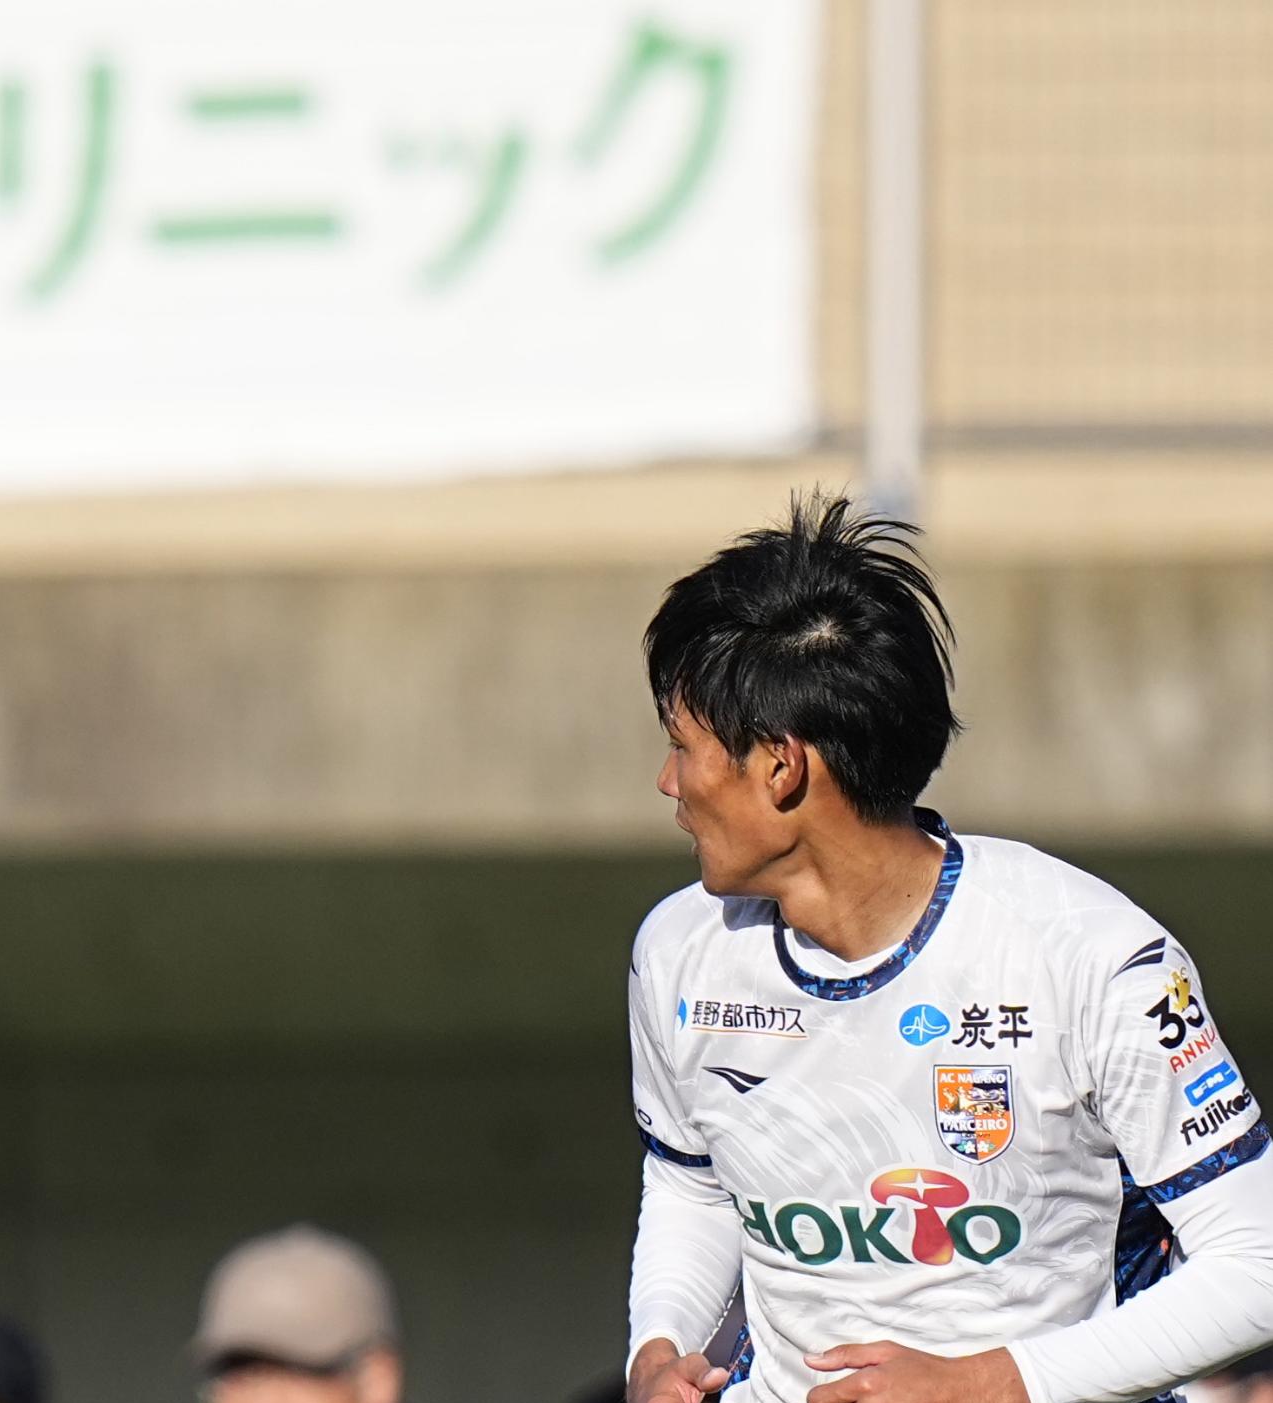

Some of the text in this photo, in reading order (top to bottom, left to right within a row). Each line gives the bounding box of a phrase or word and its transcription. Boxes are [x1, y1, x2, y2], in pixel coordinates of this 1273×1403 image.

[691, 1000, 807, 1034] 長野都市ガス
[951, 1002, 1034, 1051] 炭平
[939, 1072, 956, 1084] AC
